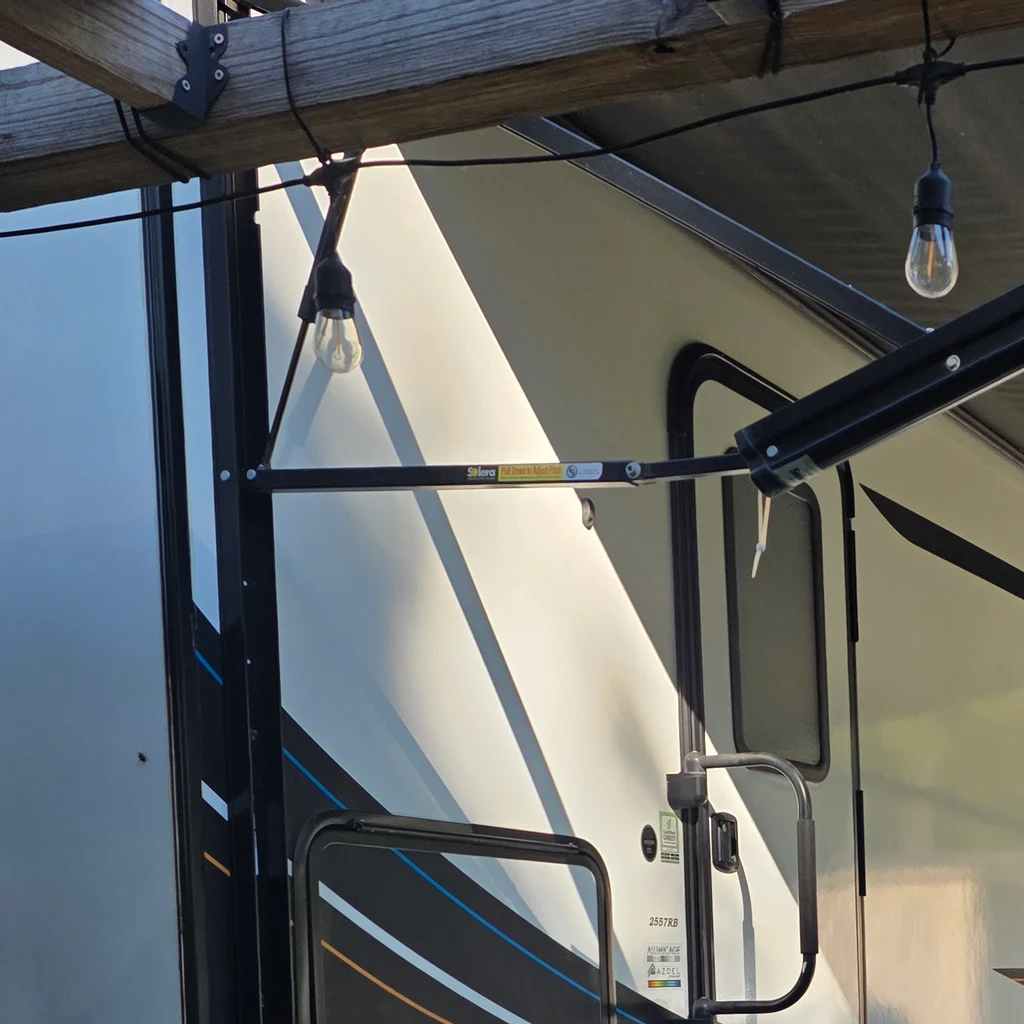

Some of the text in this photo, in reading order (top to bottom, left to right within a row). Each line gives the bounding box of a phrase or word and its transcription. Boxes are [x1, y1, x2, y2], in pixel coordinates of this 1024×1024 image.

[467, 465, 496, 478] Solera
[649, 916, 679, 928] 2557RB
[656, 967, 681, 976] AZDEL
